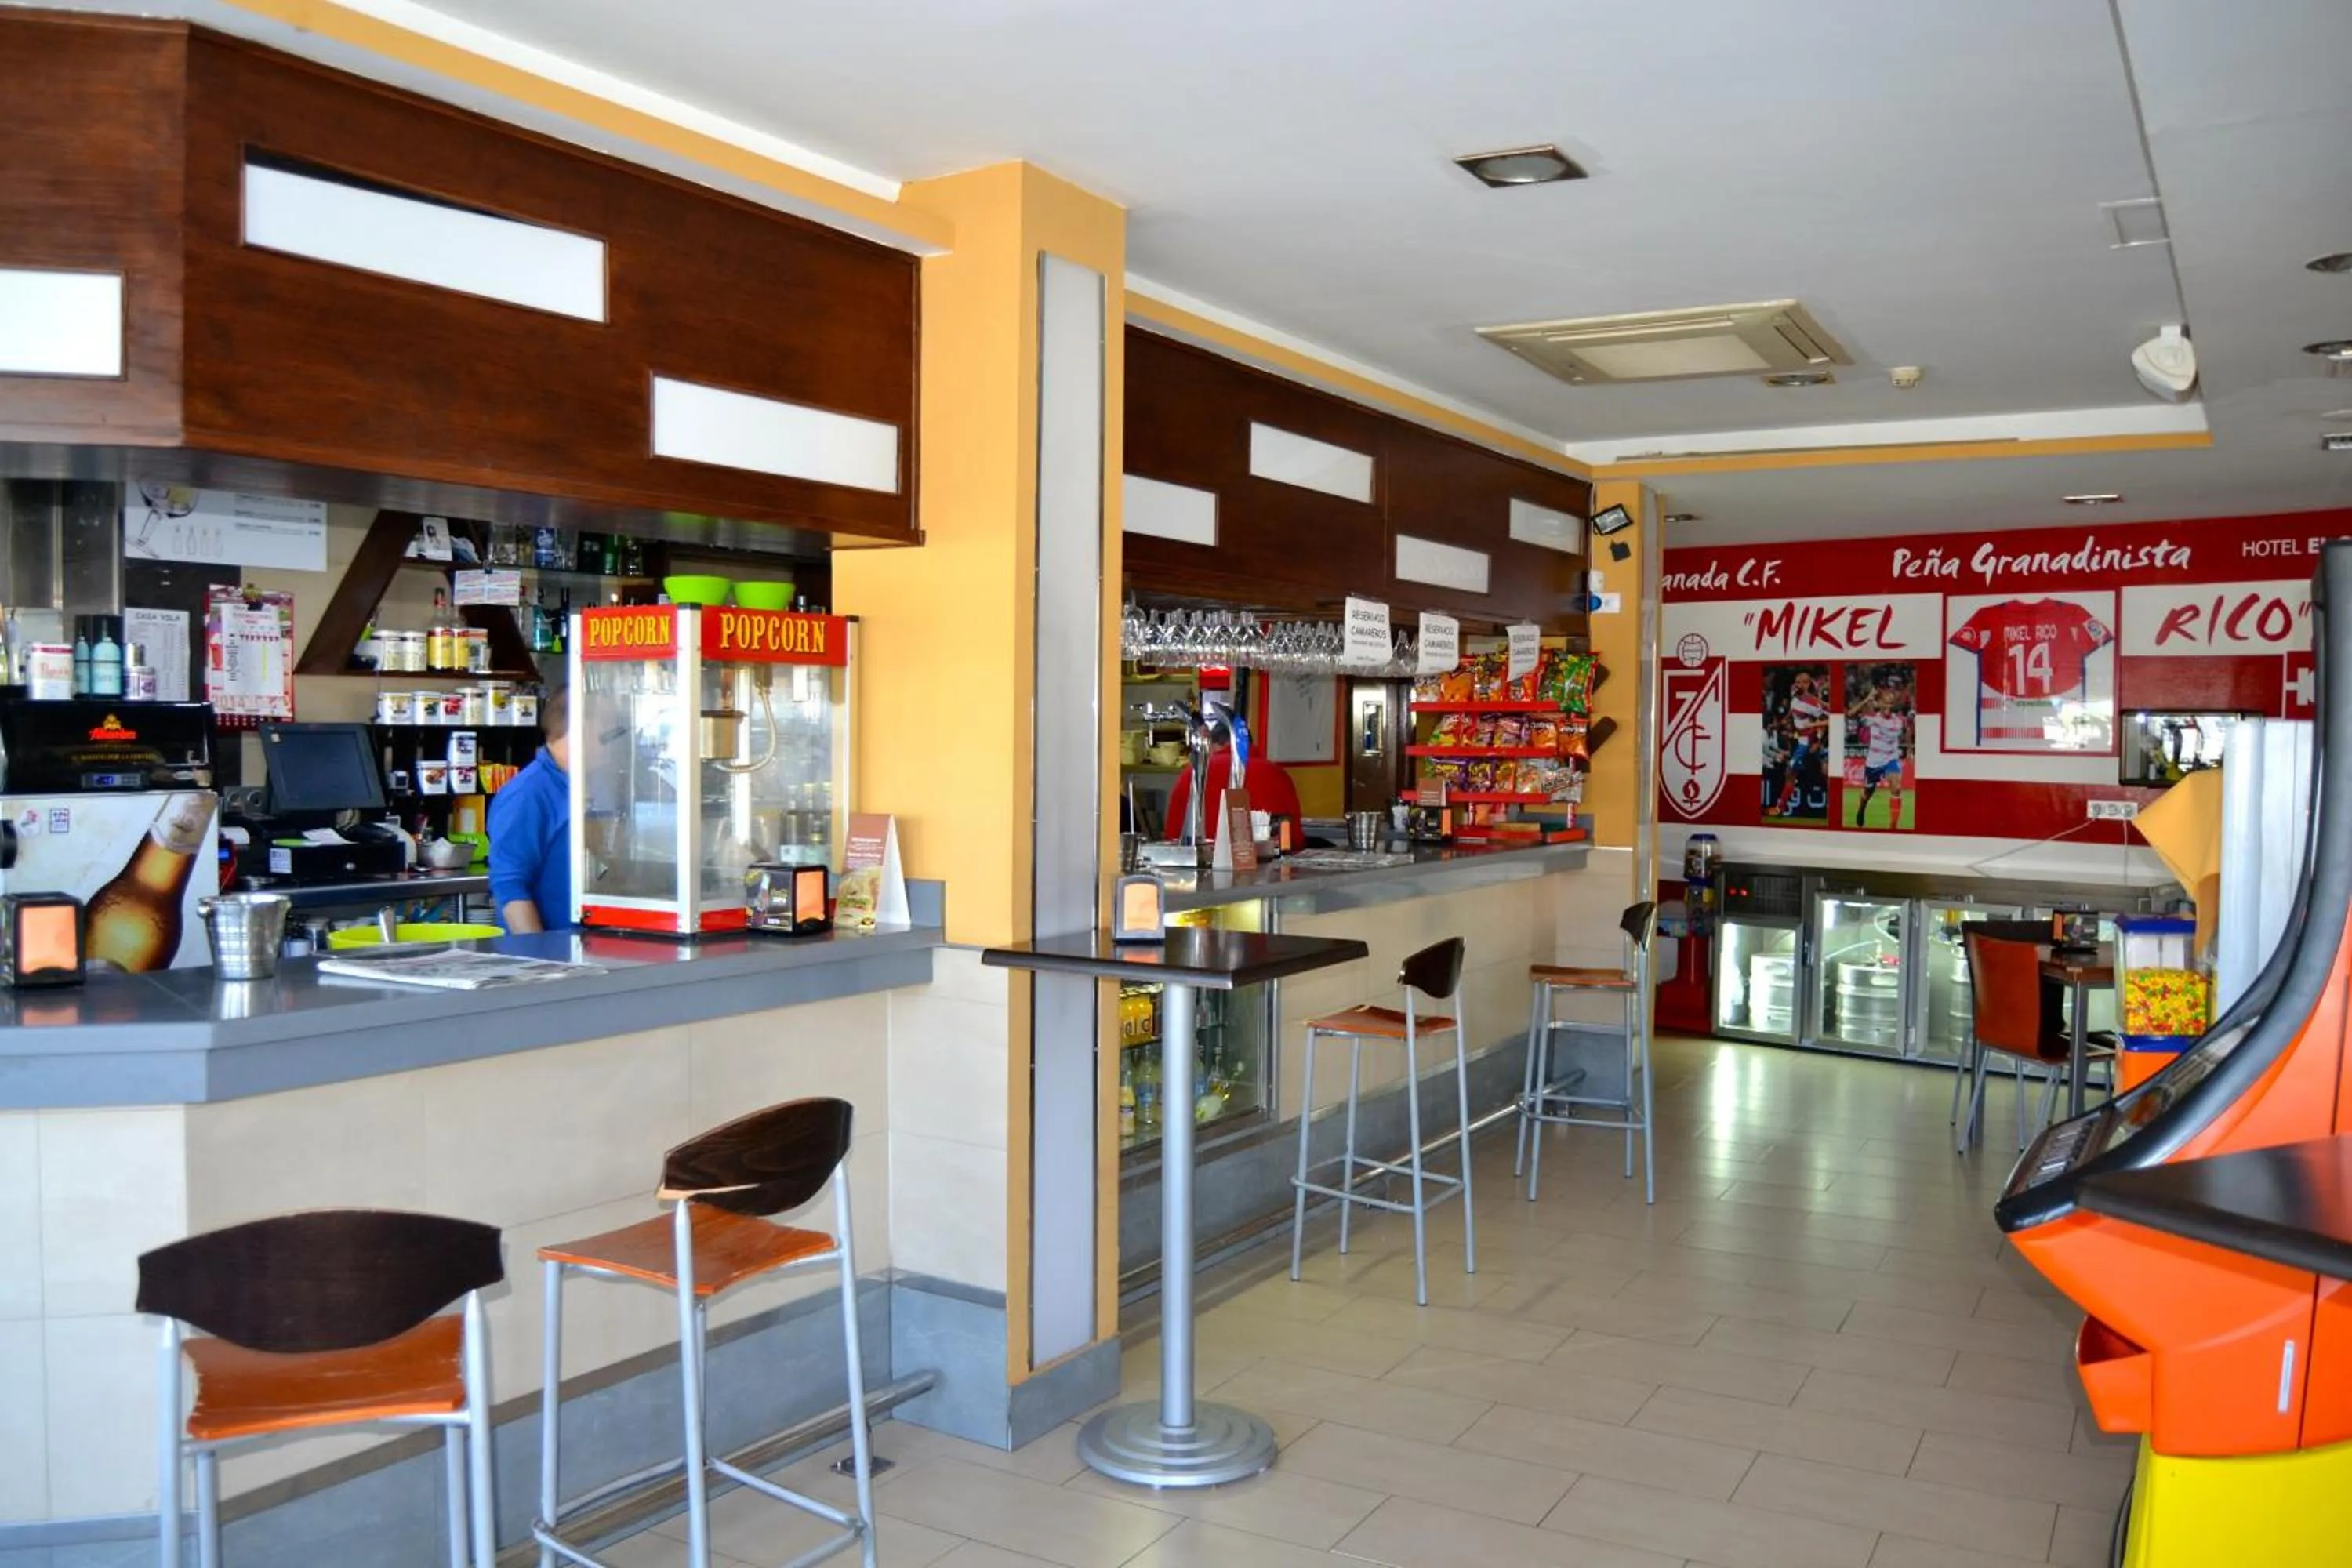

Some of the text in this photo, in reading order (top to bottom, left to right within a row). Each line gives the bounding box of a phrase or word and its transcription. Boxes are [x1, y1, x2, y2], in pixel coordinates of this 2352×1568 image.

[1892, 535, 2192, 587] Peña Granadinista
[2241, 539, 2303, 557] HOTEL
[2307, 536, 2327, 555] E
[1737, 557, 1782, 589] C.F.
[589, 615, 670, 648] POPCORN
[720, 613, 826, 654] POPCORN
[1351, 626, 1387, 639] CAMAREROS
[1744, 601, 1907, 659] "MIKEL
[2004, 624, 2058, 641] MIKEL RICO
[2008, 641, 2053, 696] 14
